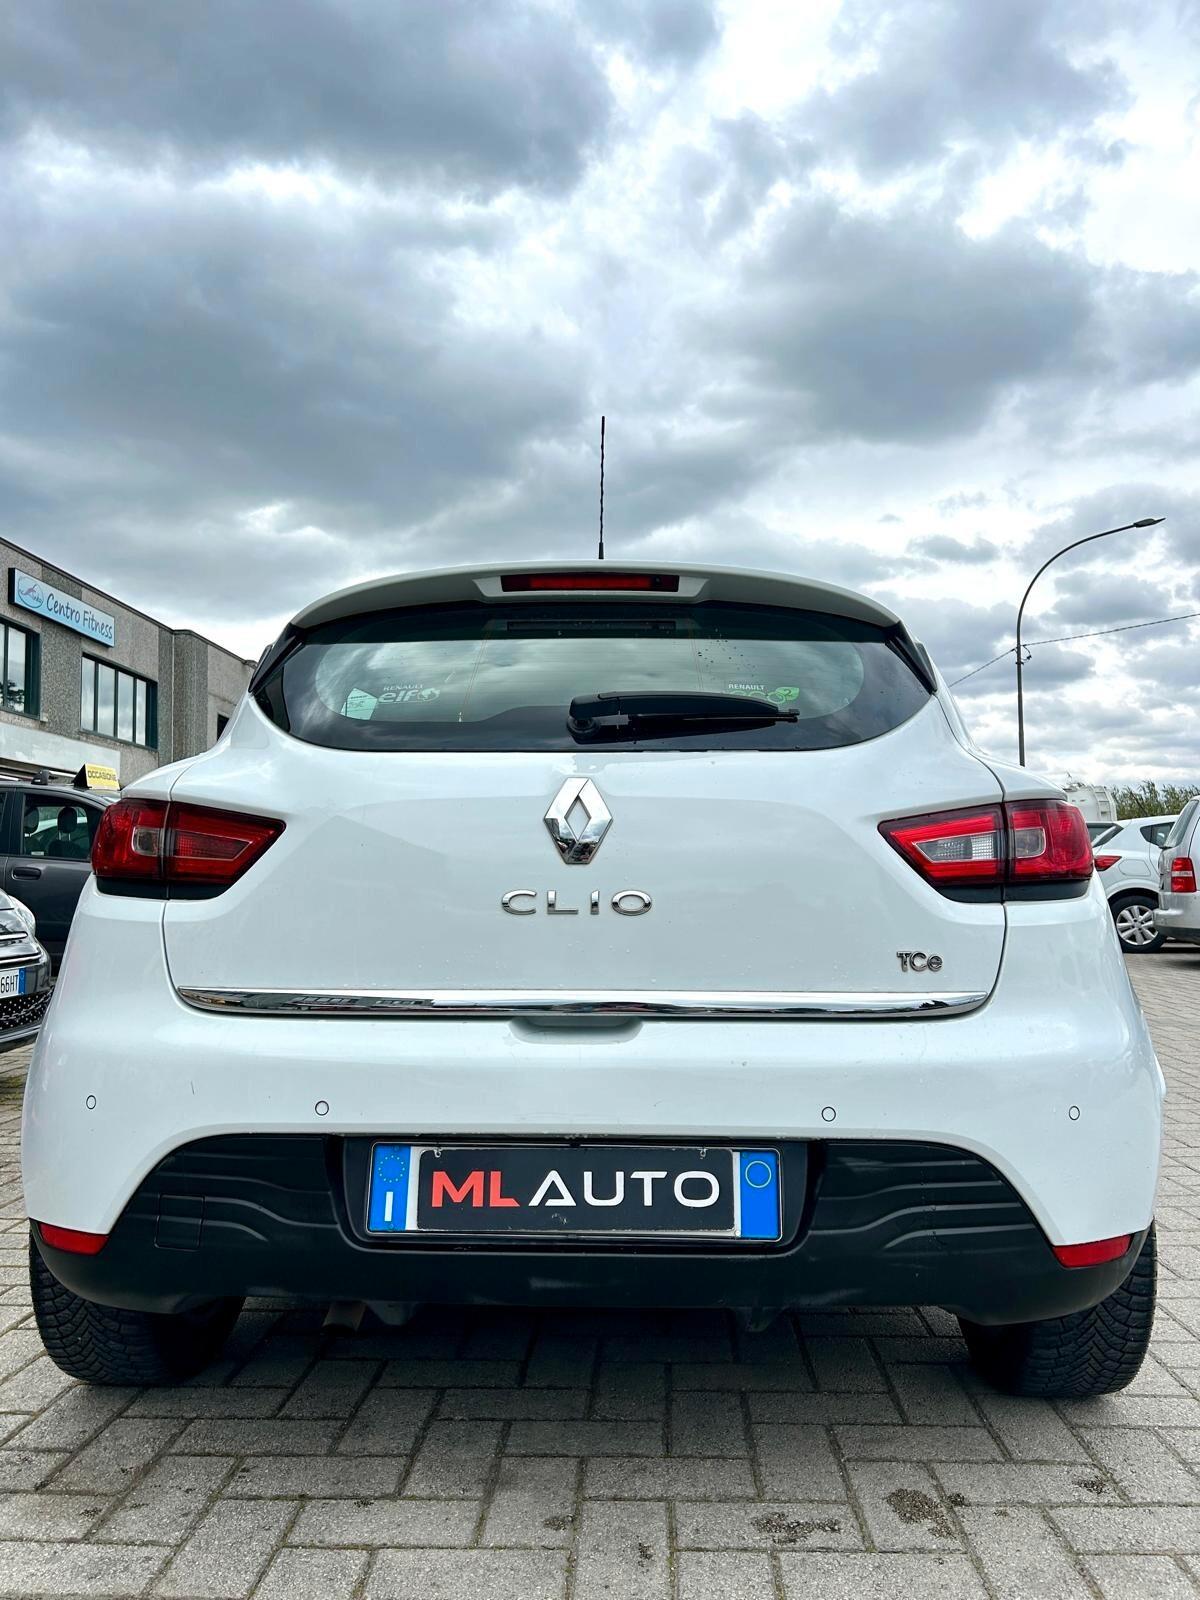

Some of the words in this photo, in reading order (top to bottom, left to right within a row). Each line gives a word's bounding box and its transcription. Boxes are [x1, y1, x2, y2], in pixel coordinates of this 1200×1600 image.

[46, 592, 81, 623] Centro
[82, 610, 113, 640] Fitness
[378, 689, 420, 704] elf
[501, 889, 653, 916] CLIO
[896, 951, 943, 973] TCe
